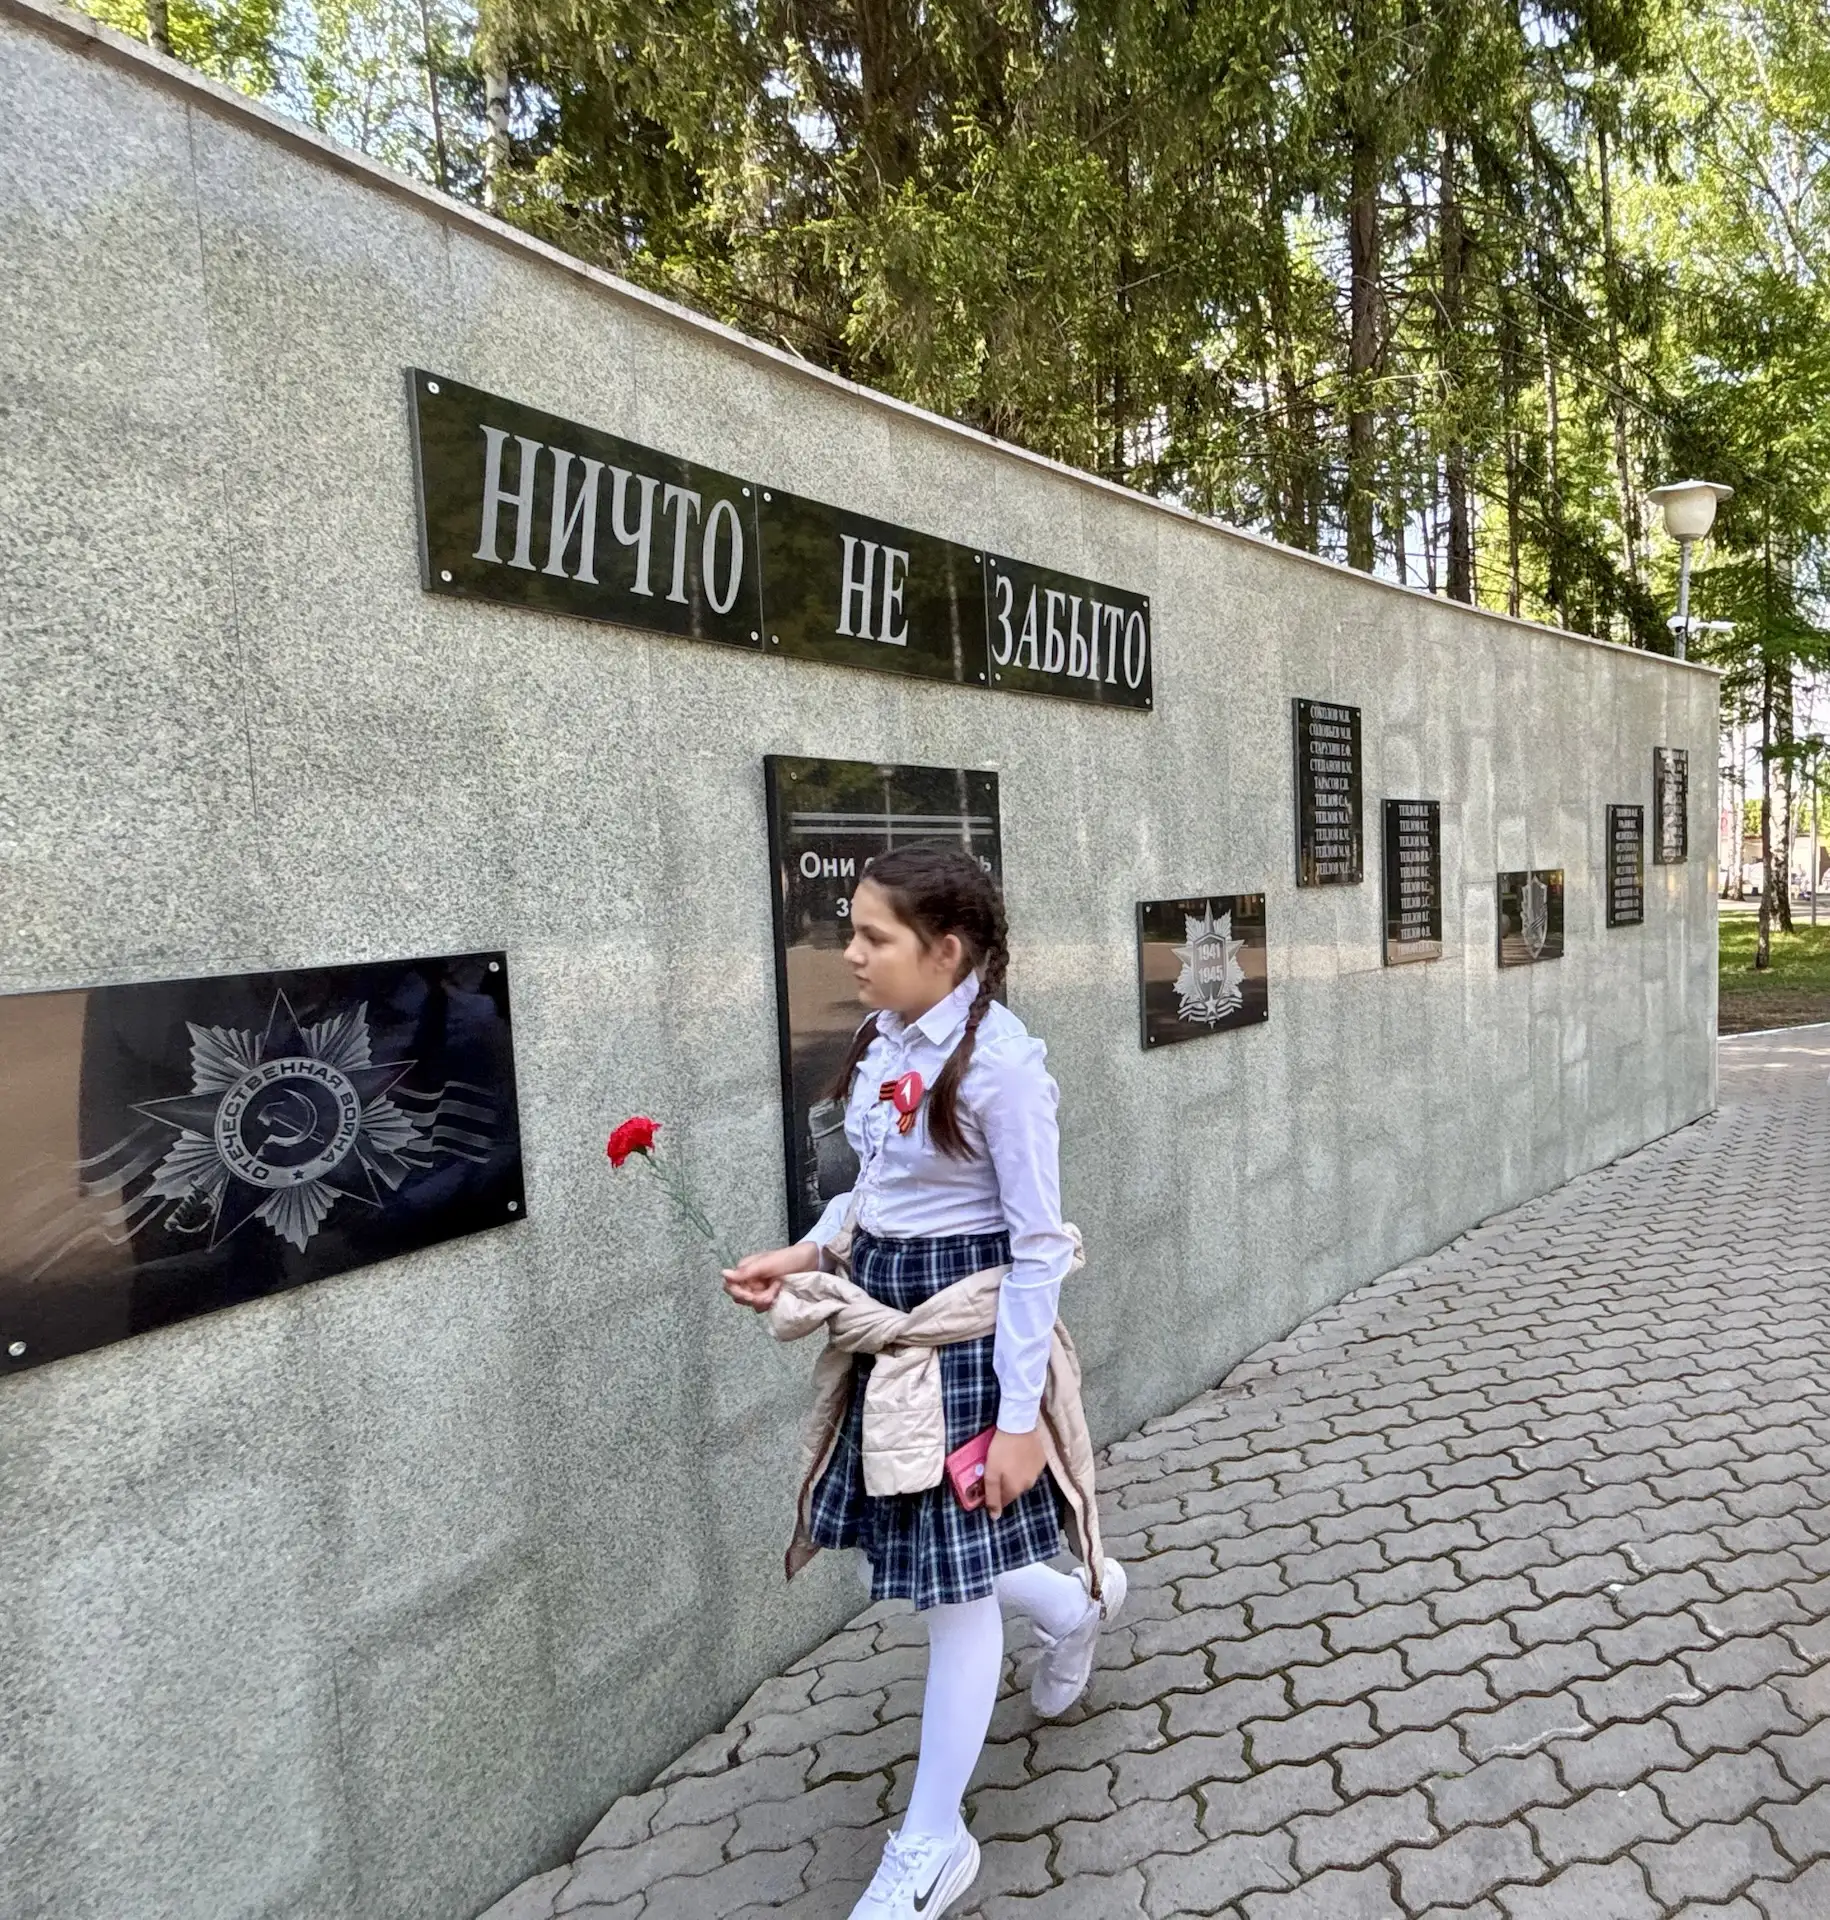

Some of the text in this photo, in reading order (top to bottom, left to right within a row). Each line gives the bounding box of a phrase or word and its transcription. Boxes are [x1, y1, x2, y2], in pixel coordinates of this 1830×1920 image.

[473, 425, 1145, 688] НИЧТО НЕ ЗАБЫТО
[800, 851, 855, 879] Они
[1199, 943, 1221, 960] 1941
[1199, 965, 1223, 983] 1945
[222, 1062, 343, 1180] ОТЕЧЕСТВЕННАЯ
